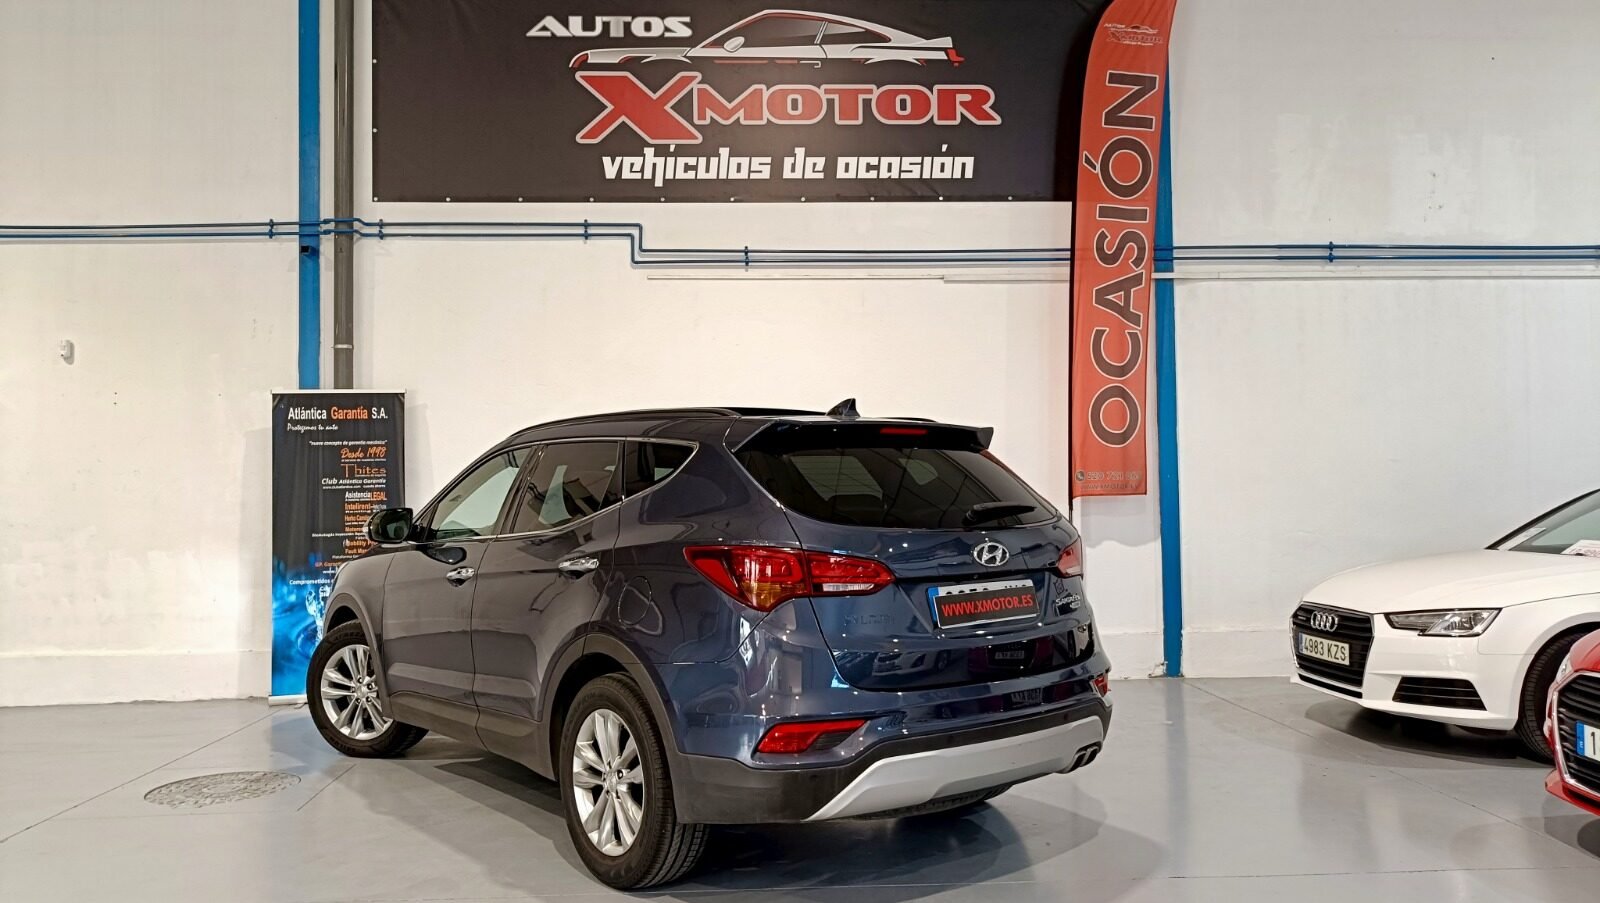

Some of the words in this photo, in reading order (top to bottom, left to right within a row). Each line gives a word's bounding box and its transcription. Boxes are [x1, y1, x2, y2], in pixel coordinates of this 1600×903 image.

[526, 16, 692, 38] AUTOS
[575, 71, 1001, 144] XMOTOR
[783, 147, 825, 179] de
[1082, 70, 1159, 447] OCASIÓN
[287, 406, 327, 420] Atlántica
[330, 405, 369, 420] Garantía
[371, 407, 389, 419] S.A.
[341, 447, 364, 459] Desde
[366, 446, 387, 458] 1998
[321, 477, 338, 485] Club
[941, 594, 1034, 617] WWW.XMOTOR.ES
[1304, 637, 1325, 657] 4983
[1327, 642, 1347, 662] KZS
